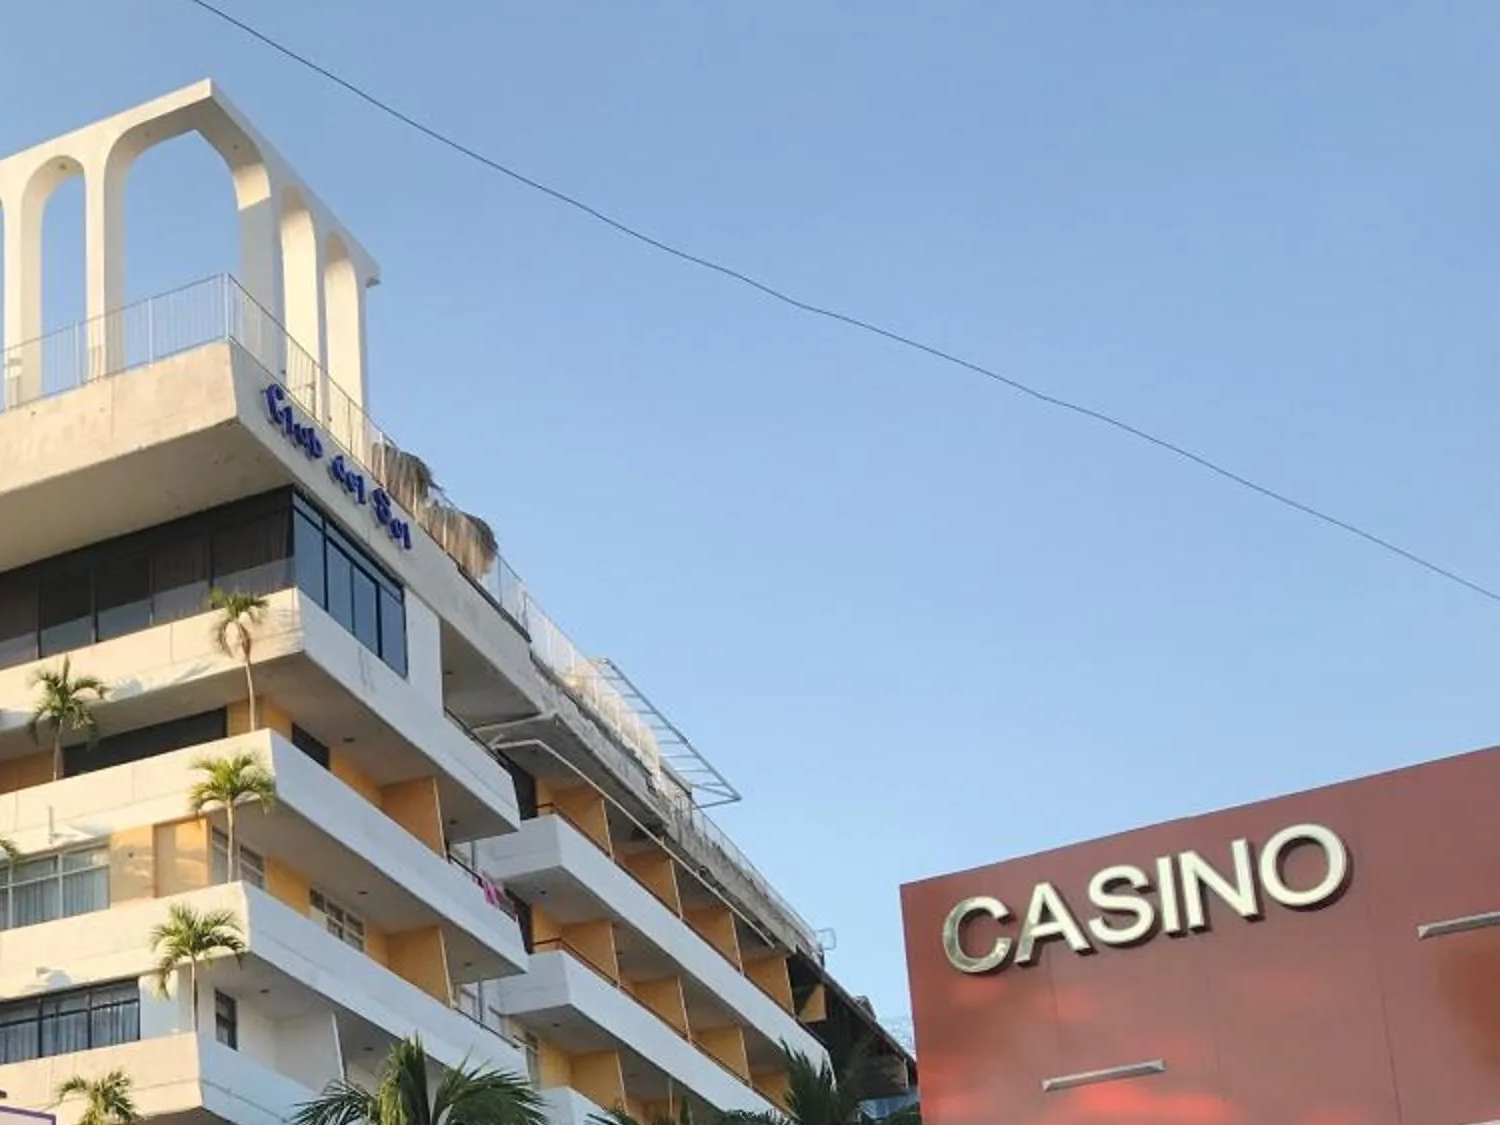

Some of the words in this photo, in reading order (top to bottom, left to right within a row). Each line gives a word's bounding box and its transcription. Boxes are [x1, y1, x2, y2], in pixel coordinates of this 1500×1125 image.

[261, 383, 324, 460] Club
[330, 455, 366, 505] del
[371, 488, 412, 550] Sol
[941, 823, 1350, 973] CASINO
